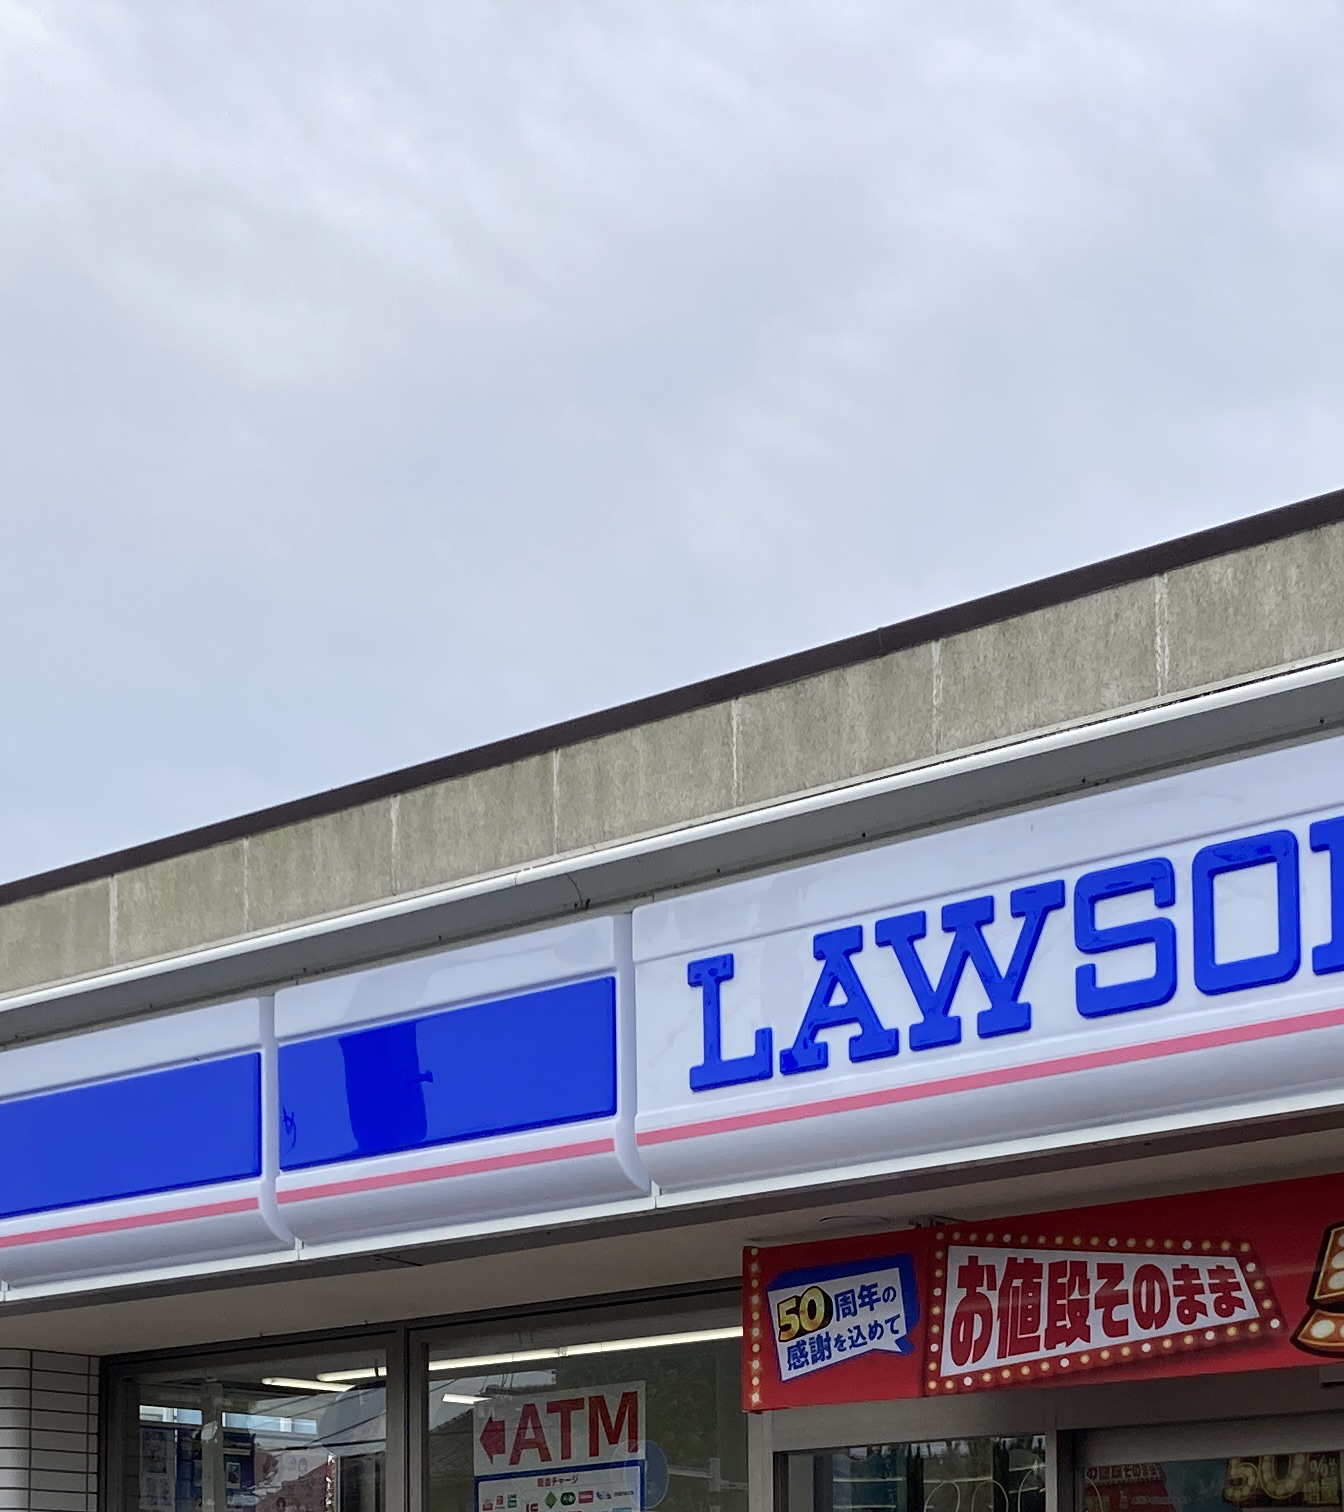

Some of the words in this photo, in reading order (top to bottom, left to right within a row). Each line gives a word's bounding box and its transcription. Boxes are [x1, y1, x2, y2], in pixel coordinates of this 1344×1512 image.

[777, 1280, 897, 1343] 50周年の
[785, 1312, 906, 1371] 感謝を込めて
[950, 1254, 1248, 1368] お値段そのまま
[508, 1390, 639, 1466] ATM
